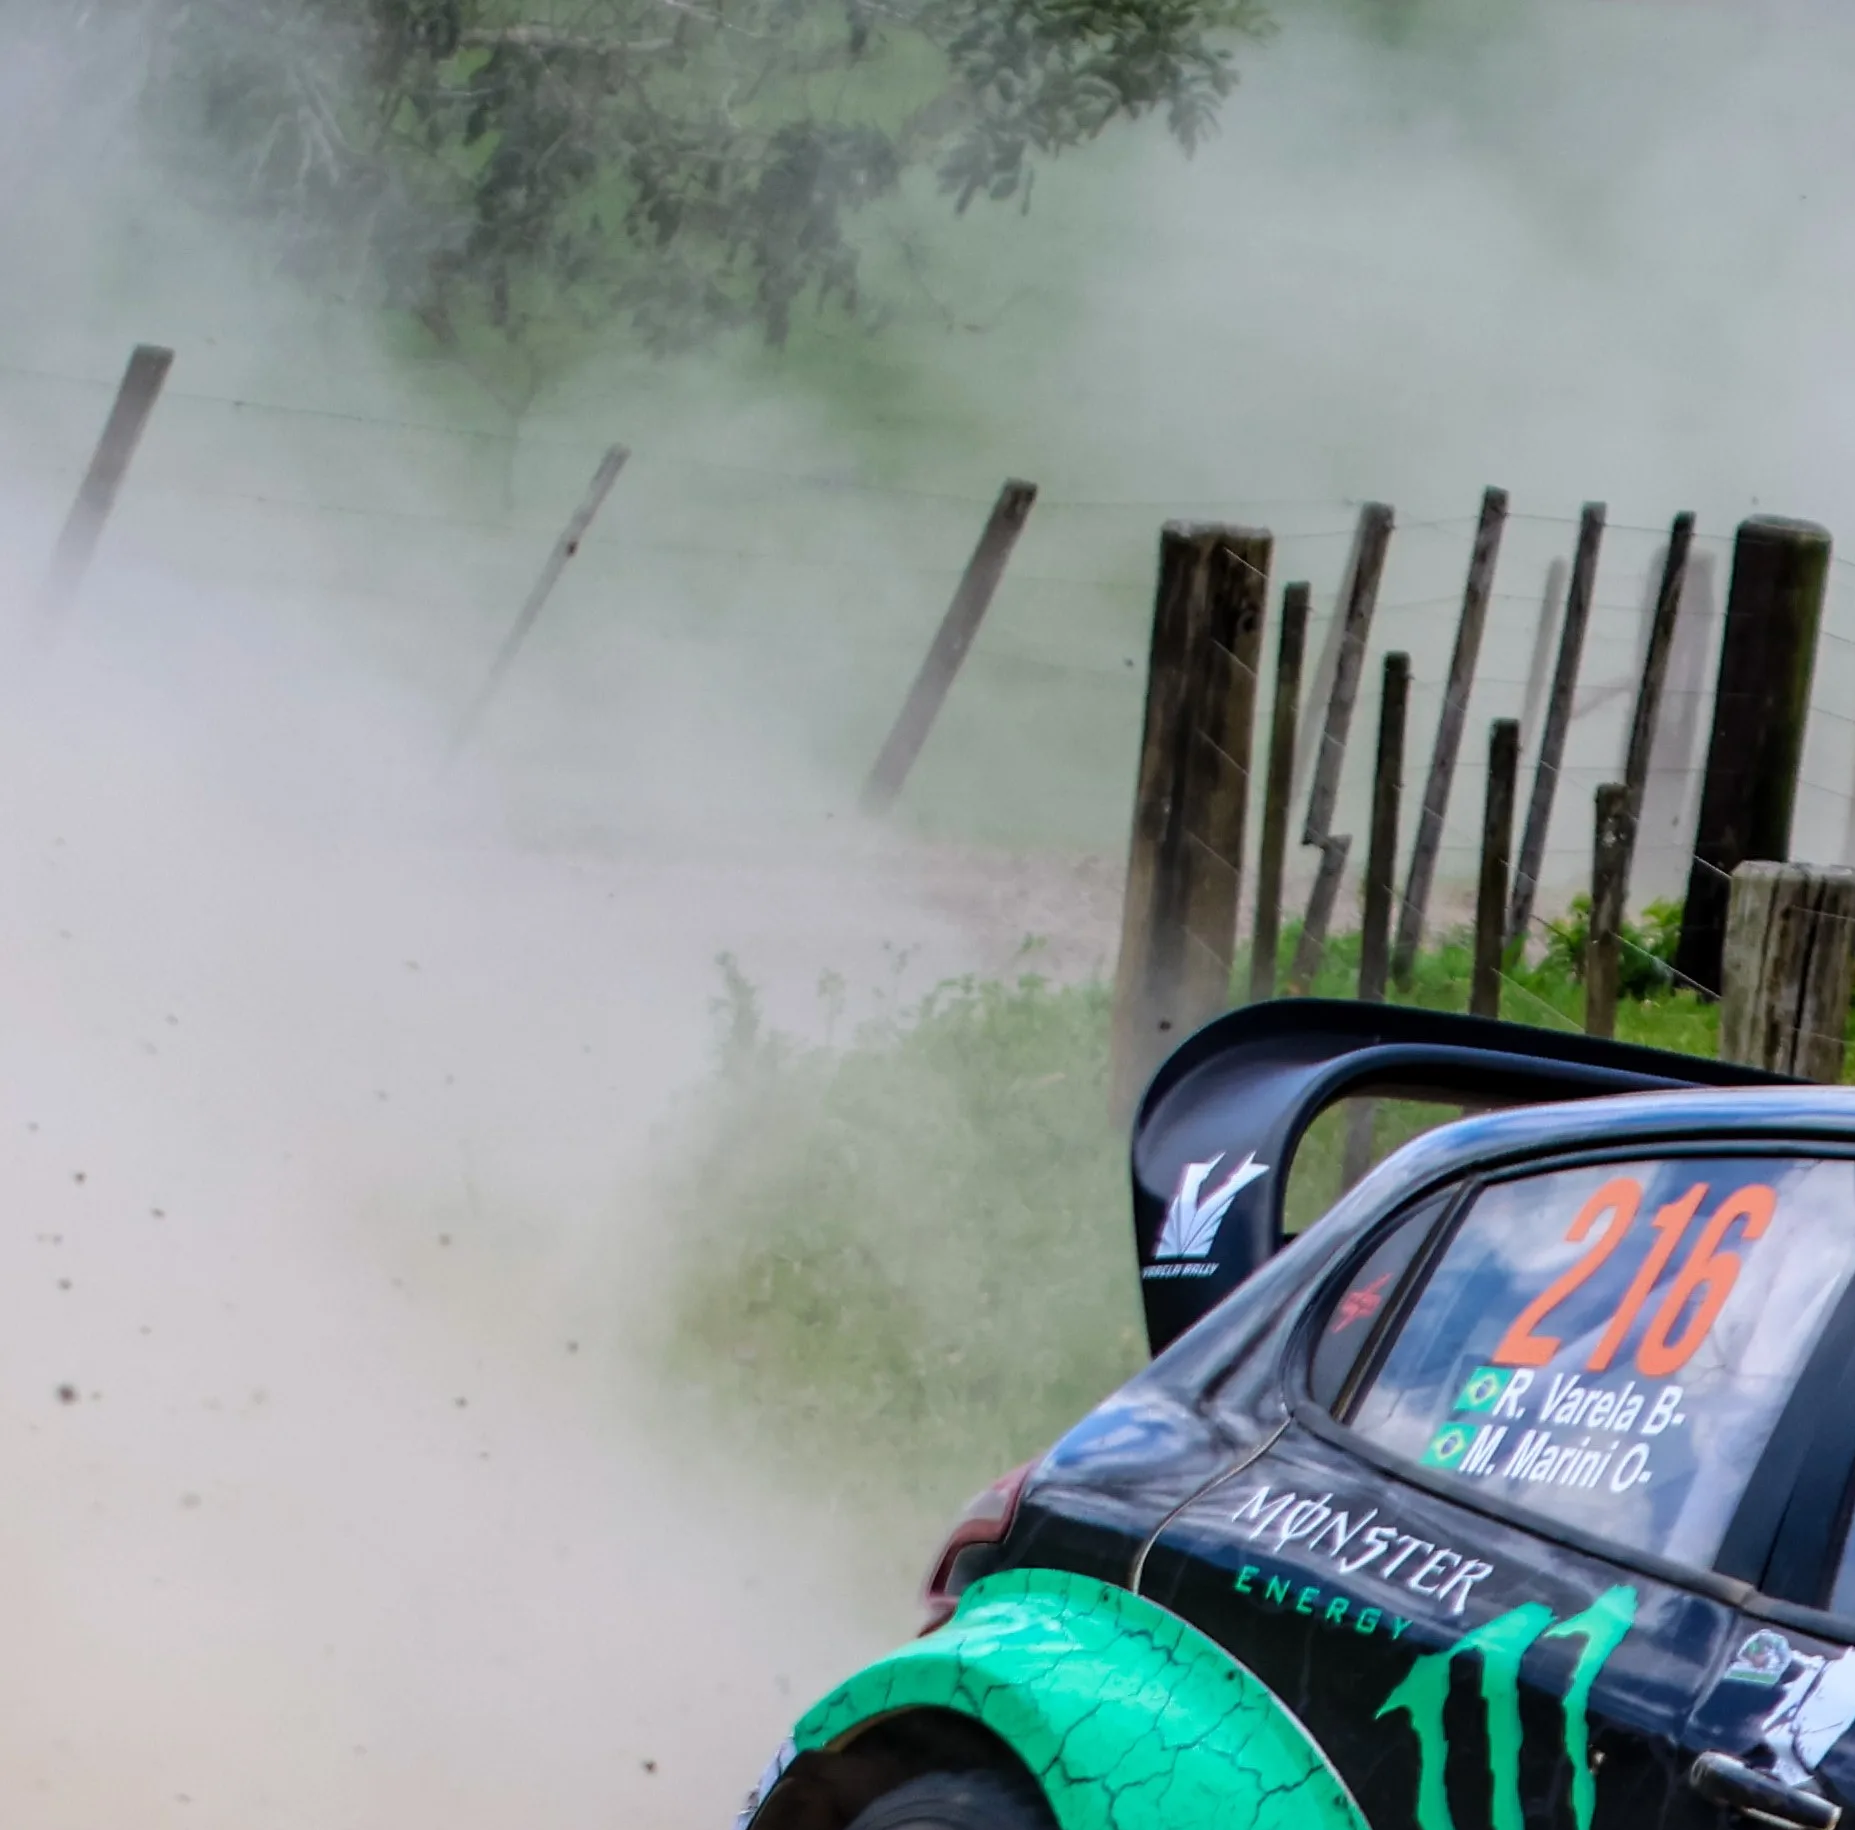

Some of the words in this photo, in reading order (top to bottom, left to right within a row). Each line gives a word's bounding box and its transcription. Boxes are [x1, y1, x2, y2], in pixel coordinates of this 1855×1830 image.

[1491, 1177, 1777, 1377] 216
[1492, 1368, 1535, 1421] R.
[1540, 1372, 1645, 1431] Varela
[1458, 1424, 1508, 1476] M.
[1503, 1428, 1620, 1487] Marini
[1232, 1564, 1414, 1641] ENERGY
